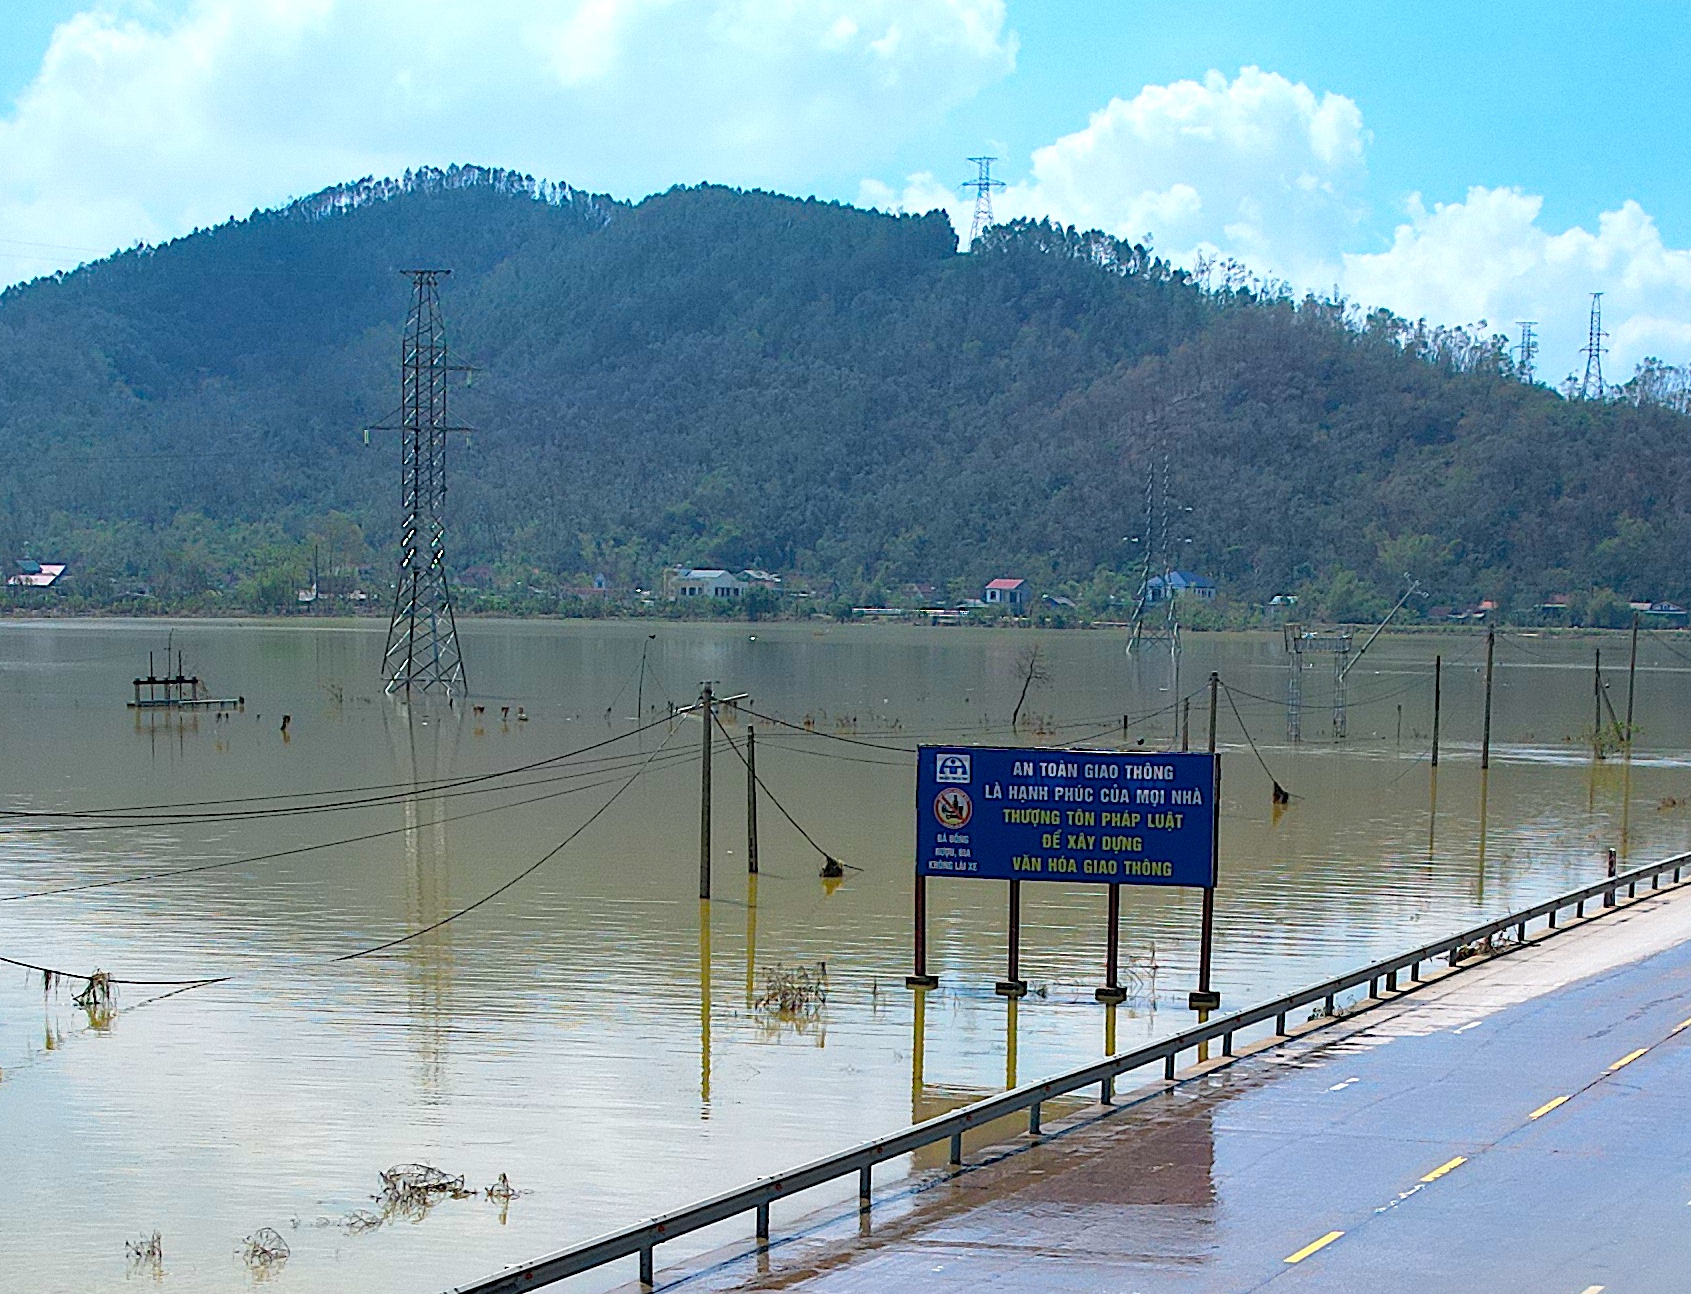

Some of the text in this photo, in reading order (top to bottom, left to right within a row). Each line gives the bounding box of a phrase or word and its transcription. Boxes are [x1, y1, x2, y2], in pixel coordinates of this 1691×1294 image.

[1013, 760, 1174, 780] AN TOÀN GIAO THÔNG
[985, 782, 1202, 807] LÀ HẠNH PHÚC CỦA MỌI NHÀ
[1002, 808, 1183, 831] THƯỢNG TÔN PHÁP LUẬT
[1042, 829, 1142, 854] ĐỂ XÂY DỰNG
[1012, 854, 1172, 876] VĂN HÓA GIAO THÔNG
